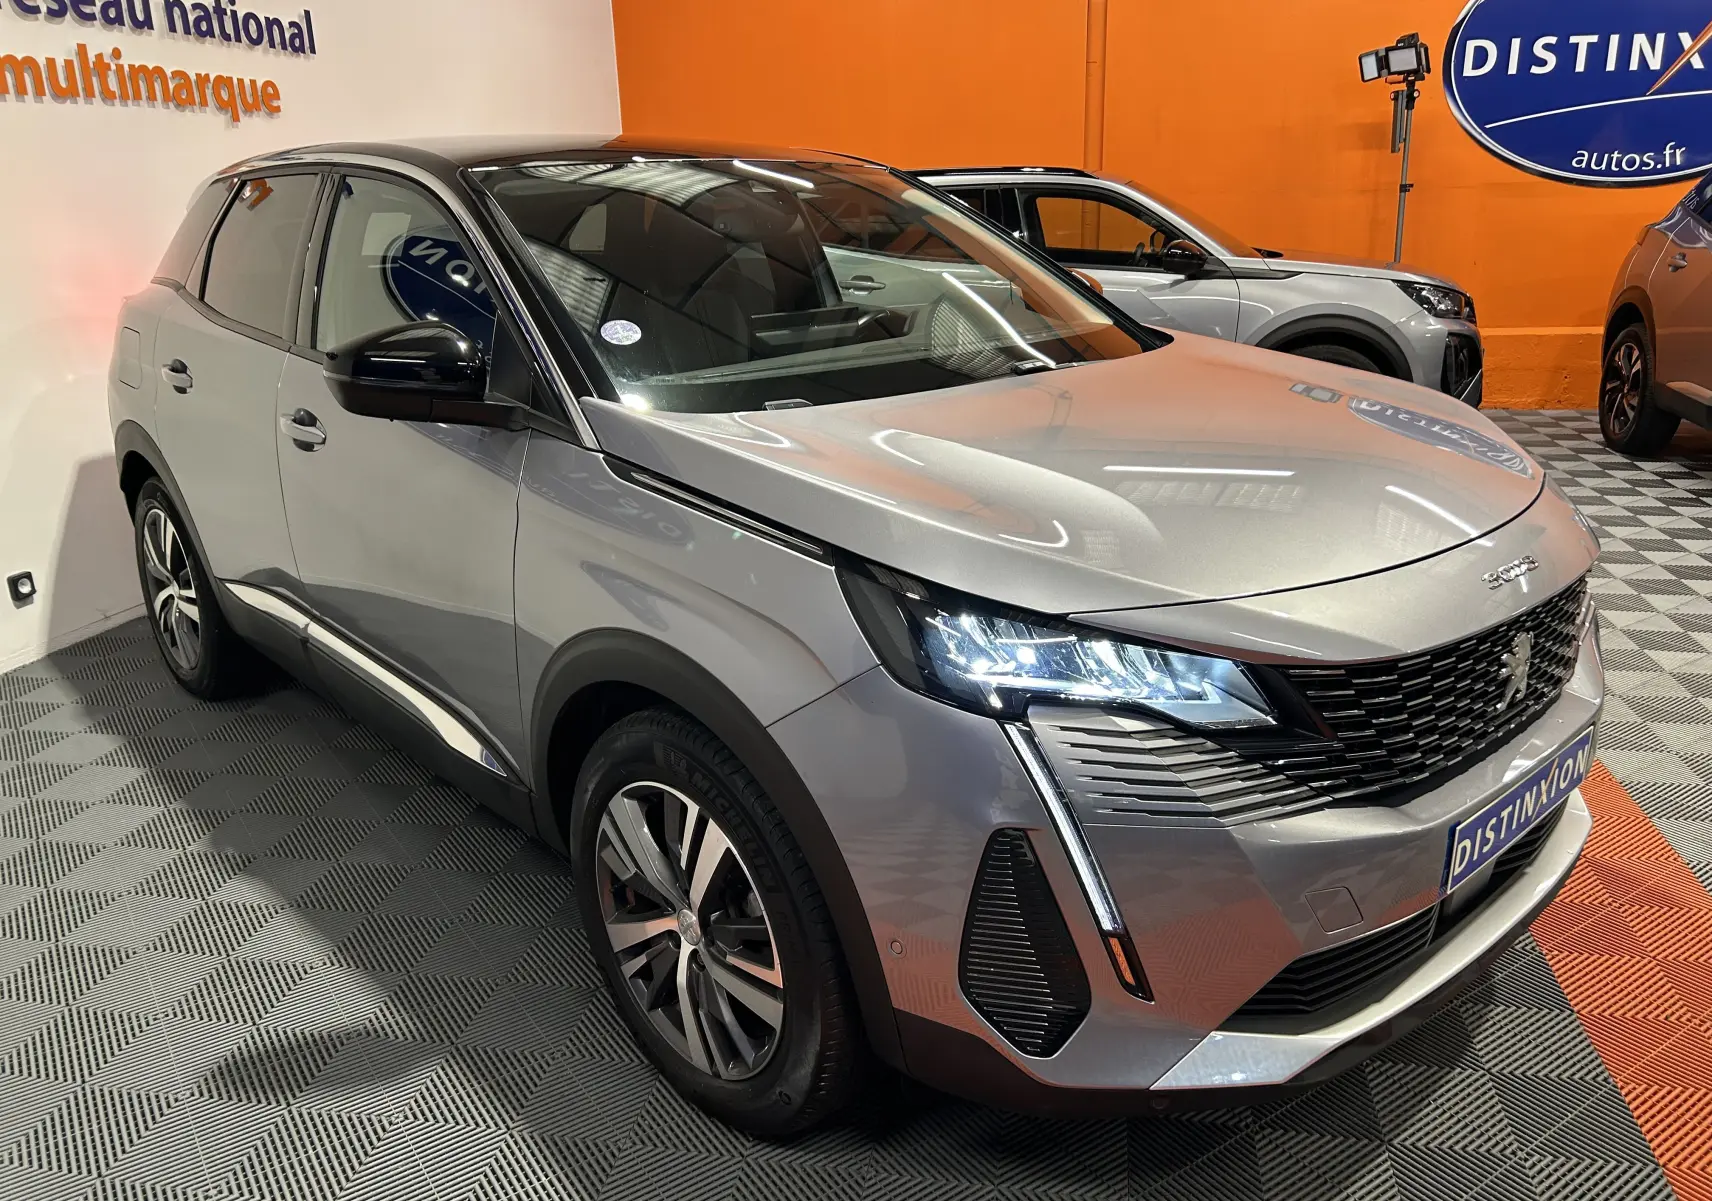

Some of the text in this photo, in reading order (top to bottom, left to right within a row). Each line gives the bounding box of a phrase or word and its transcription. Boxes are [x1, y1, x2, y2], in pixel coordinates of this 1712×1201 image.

[162, 0, 317, 55] national
[1462, 32, 1708, 78] DISTINX
[0, 42, 282, 123] multimarque
[1571, 142, 1686, 171] autos.fr
[690, 771, 778, 888] MICHELIN
[1453, 744, 1590, 877] DISTINXION
